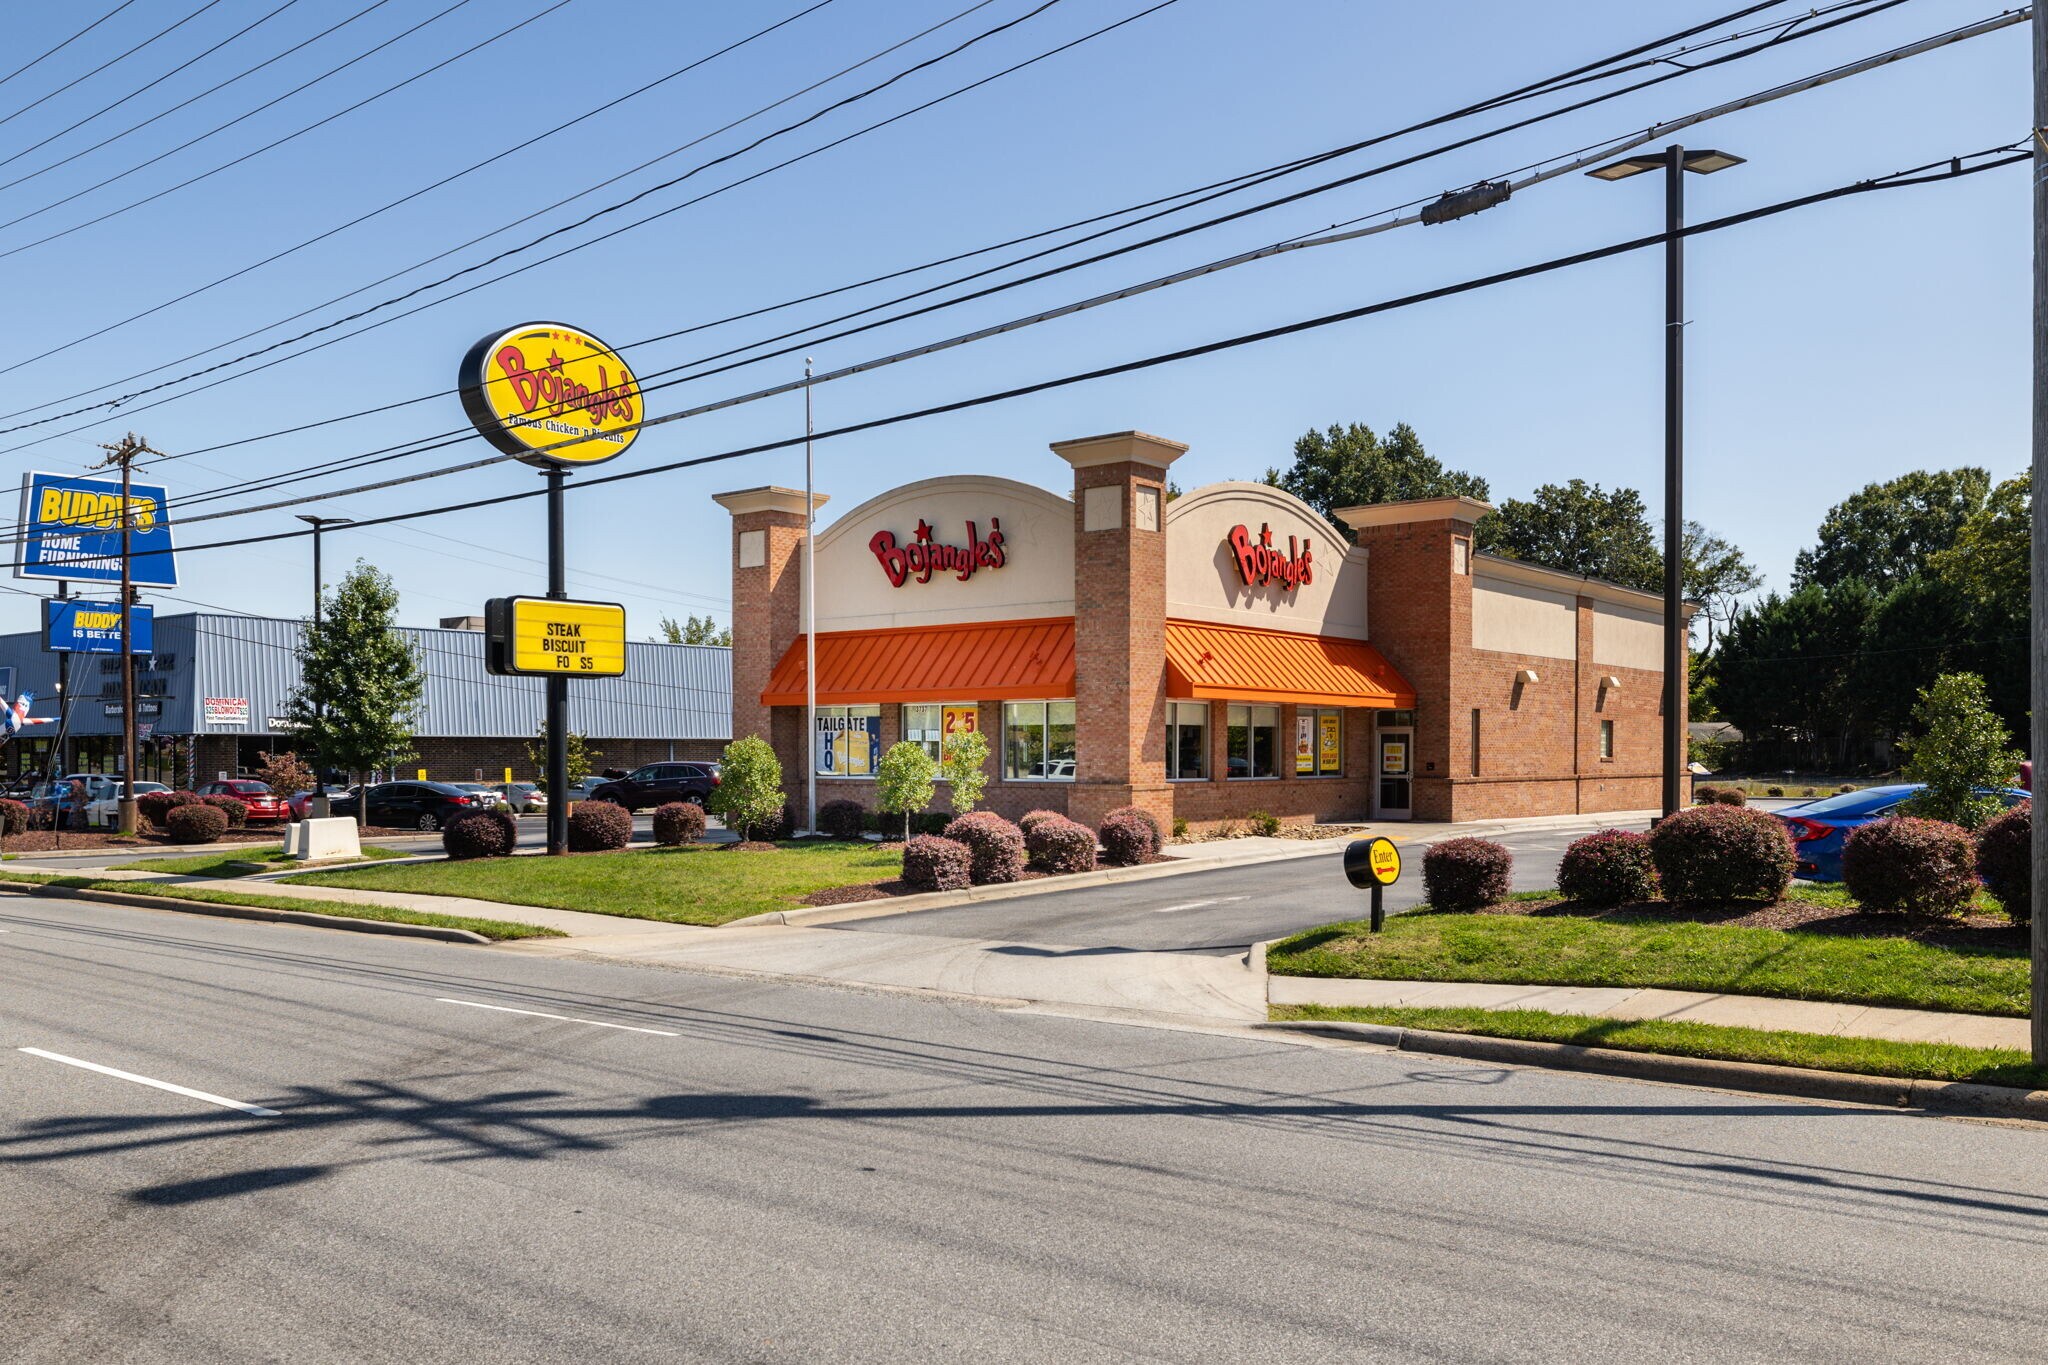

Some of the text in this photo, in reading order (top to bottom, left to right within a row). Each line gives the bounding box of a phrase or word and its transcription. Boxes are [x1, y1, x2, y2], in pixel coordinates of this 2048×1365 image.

[508, 413, 542, 430] Famous
[545, 419, 580, 437] Chicken
[41, 532, 81, 550] HOME
[74, 611, 123, 631] BUDDY'
[72, 629, 131, 641] IS BETTE
[547, 623, 581, 637] STEAK
[543, 639, 586, 653] BISCUIT
[205, 698, 247, 706] DOMINICAN
[817, 717, 865, 731] TAILGATE
[946, 711, 955, 733] 2
[1373, 849, 1393, 864] Enter
